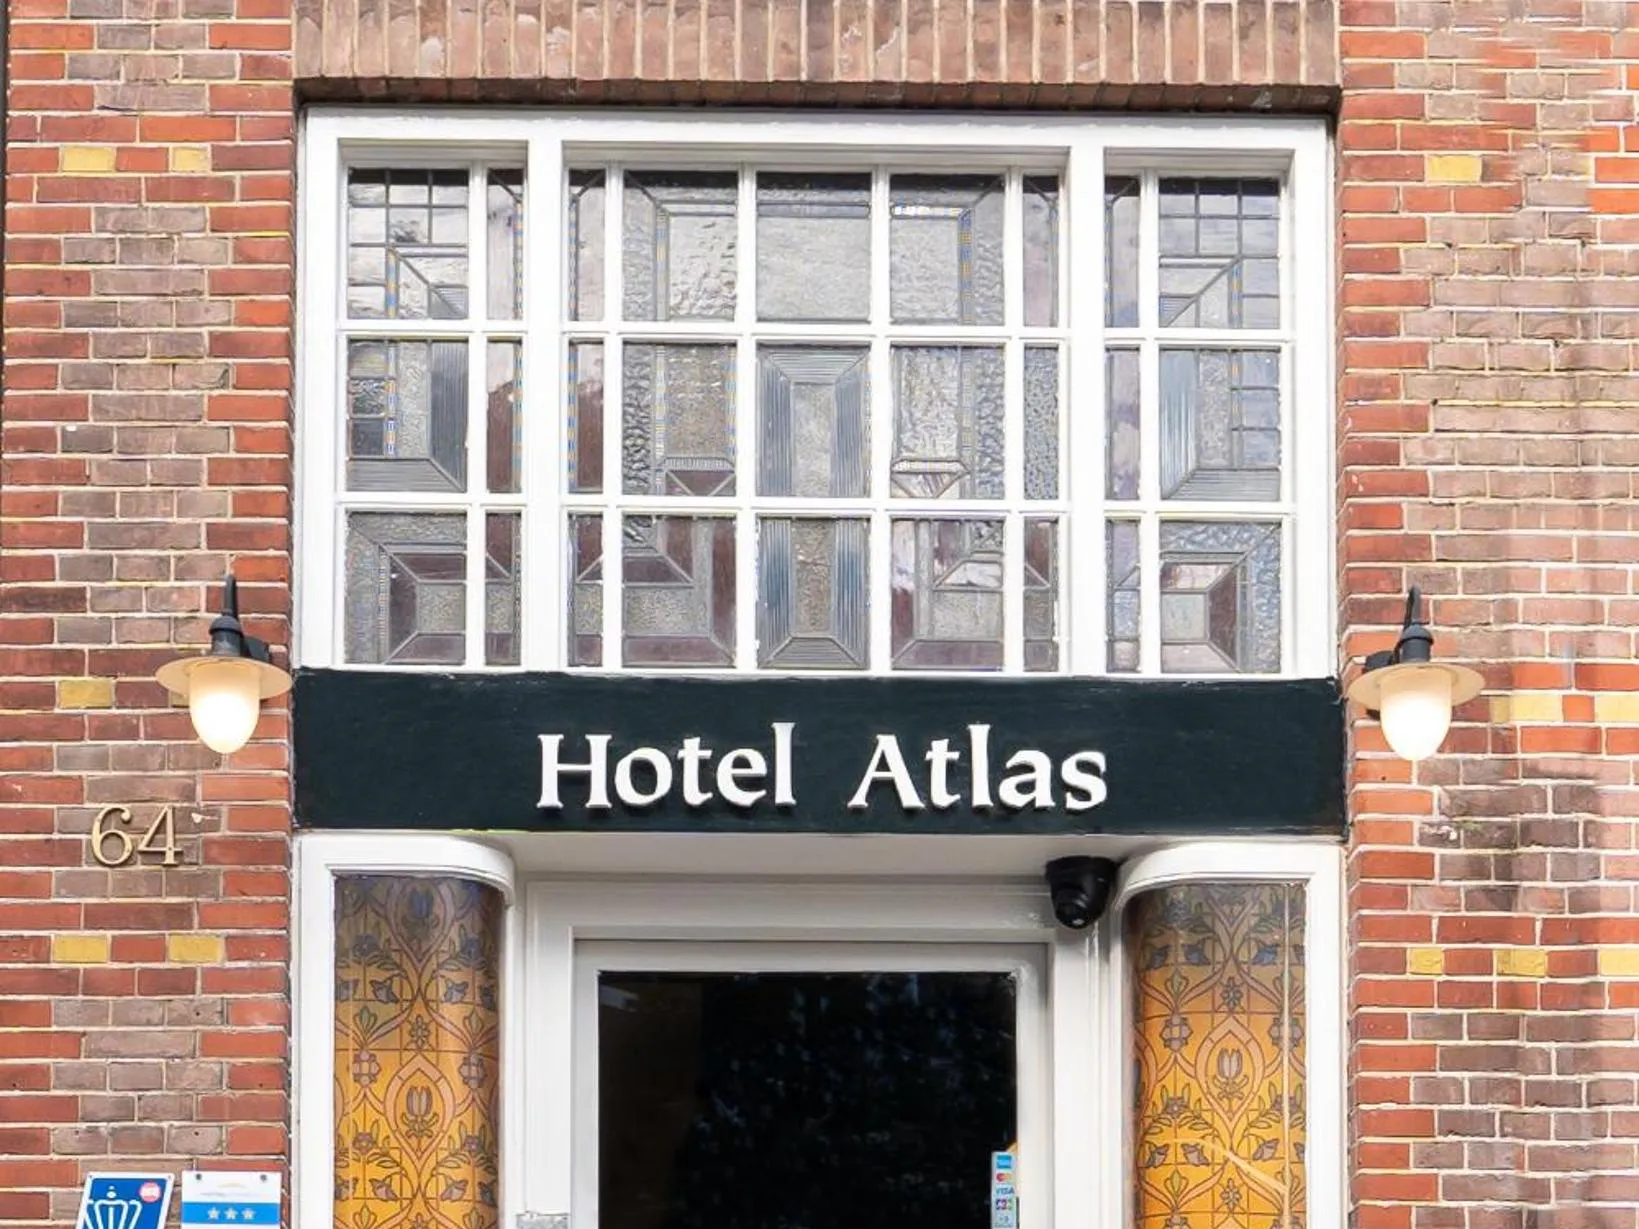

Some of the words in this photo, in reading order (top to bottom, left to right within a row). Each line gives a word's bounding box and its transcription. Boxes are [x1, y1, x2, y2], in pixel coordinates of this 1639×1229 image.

[536, 722, 797, 809] Hotel
[847, 723, 1109, 812] Atlas
[91, 804, 183, 867] 64
